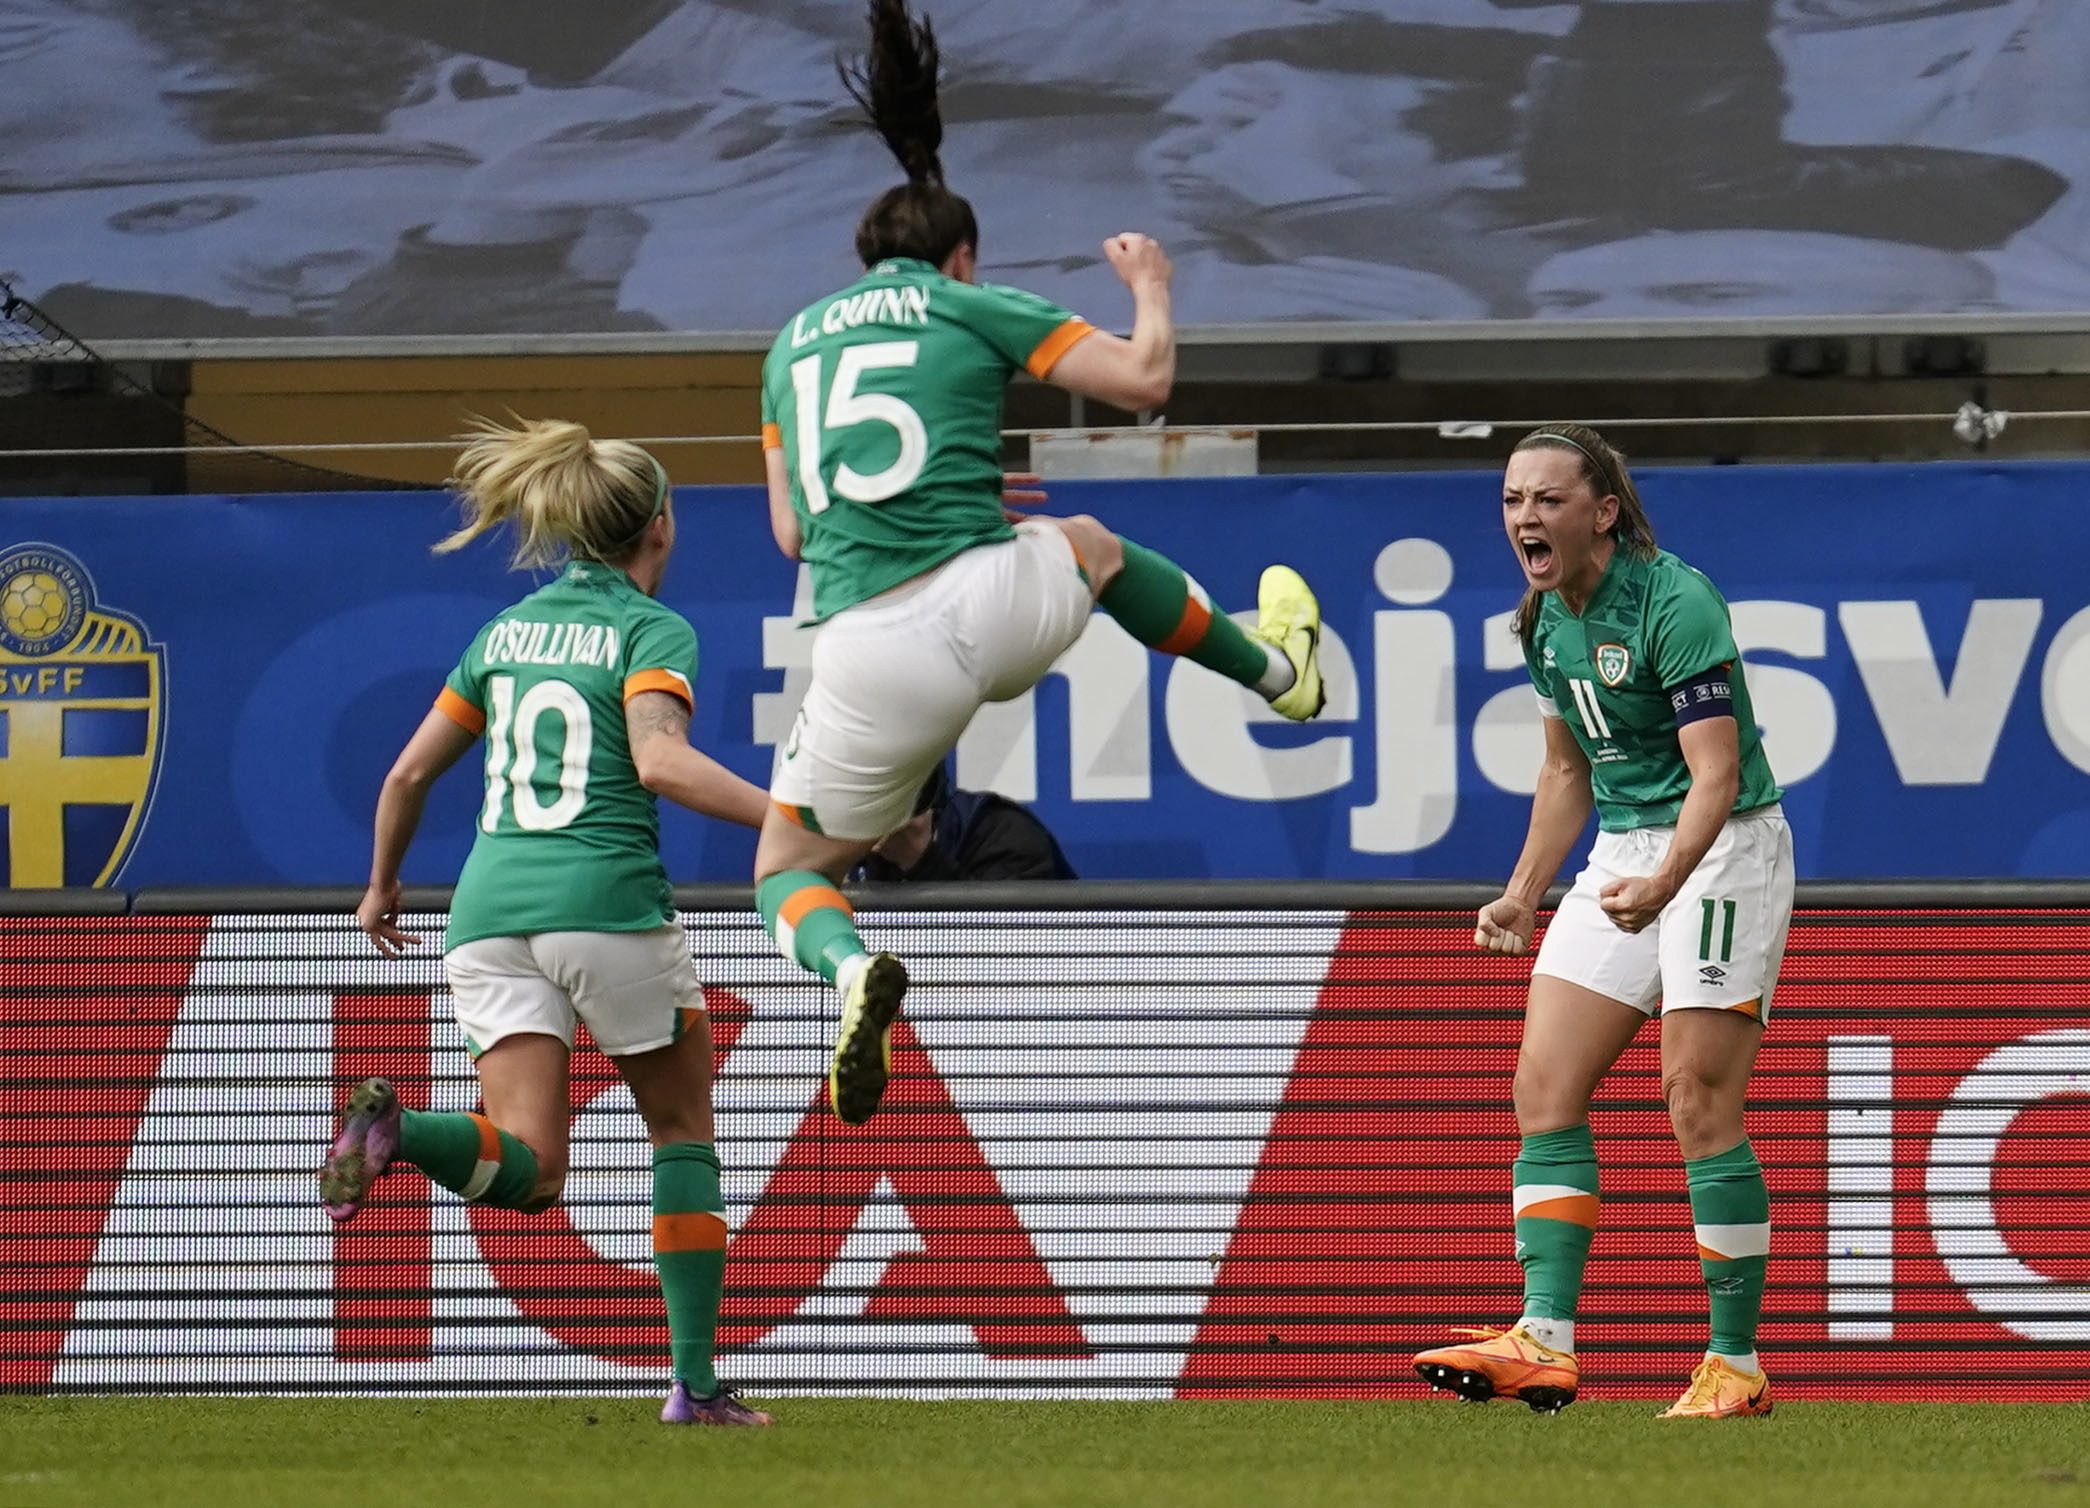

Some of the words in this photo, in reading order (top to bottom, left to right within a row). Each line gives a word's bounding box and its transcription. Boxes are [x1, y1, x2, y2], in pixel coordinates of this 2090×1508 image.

[791, 312, 819, 348] L.
[822, 284, 930, 335] QUINN
[791, 340, 928, 514] 15
[483, 618, 620, 670] O'SULLIVAN
[1569, 678, 1612, 739] 11
[481, 676, 593, 831] 10
[1699, 898, 1736, 962] 11
[332, 985, 1093, 1369] ICA
